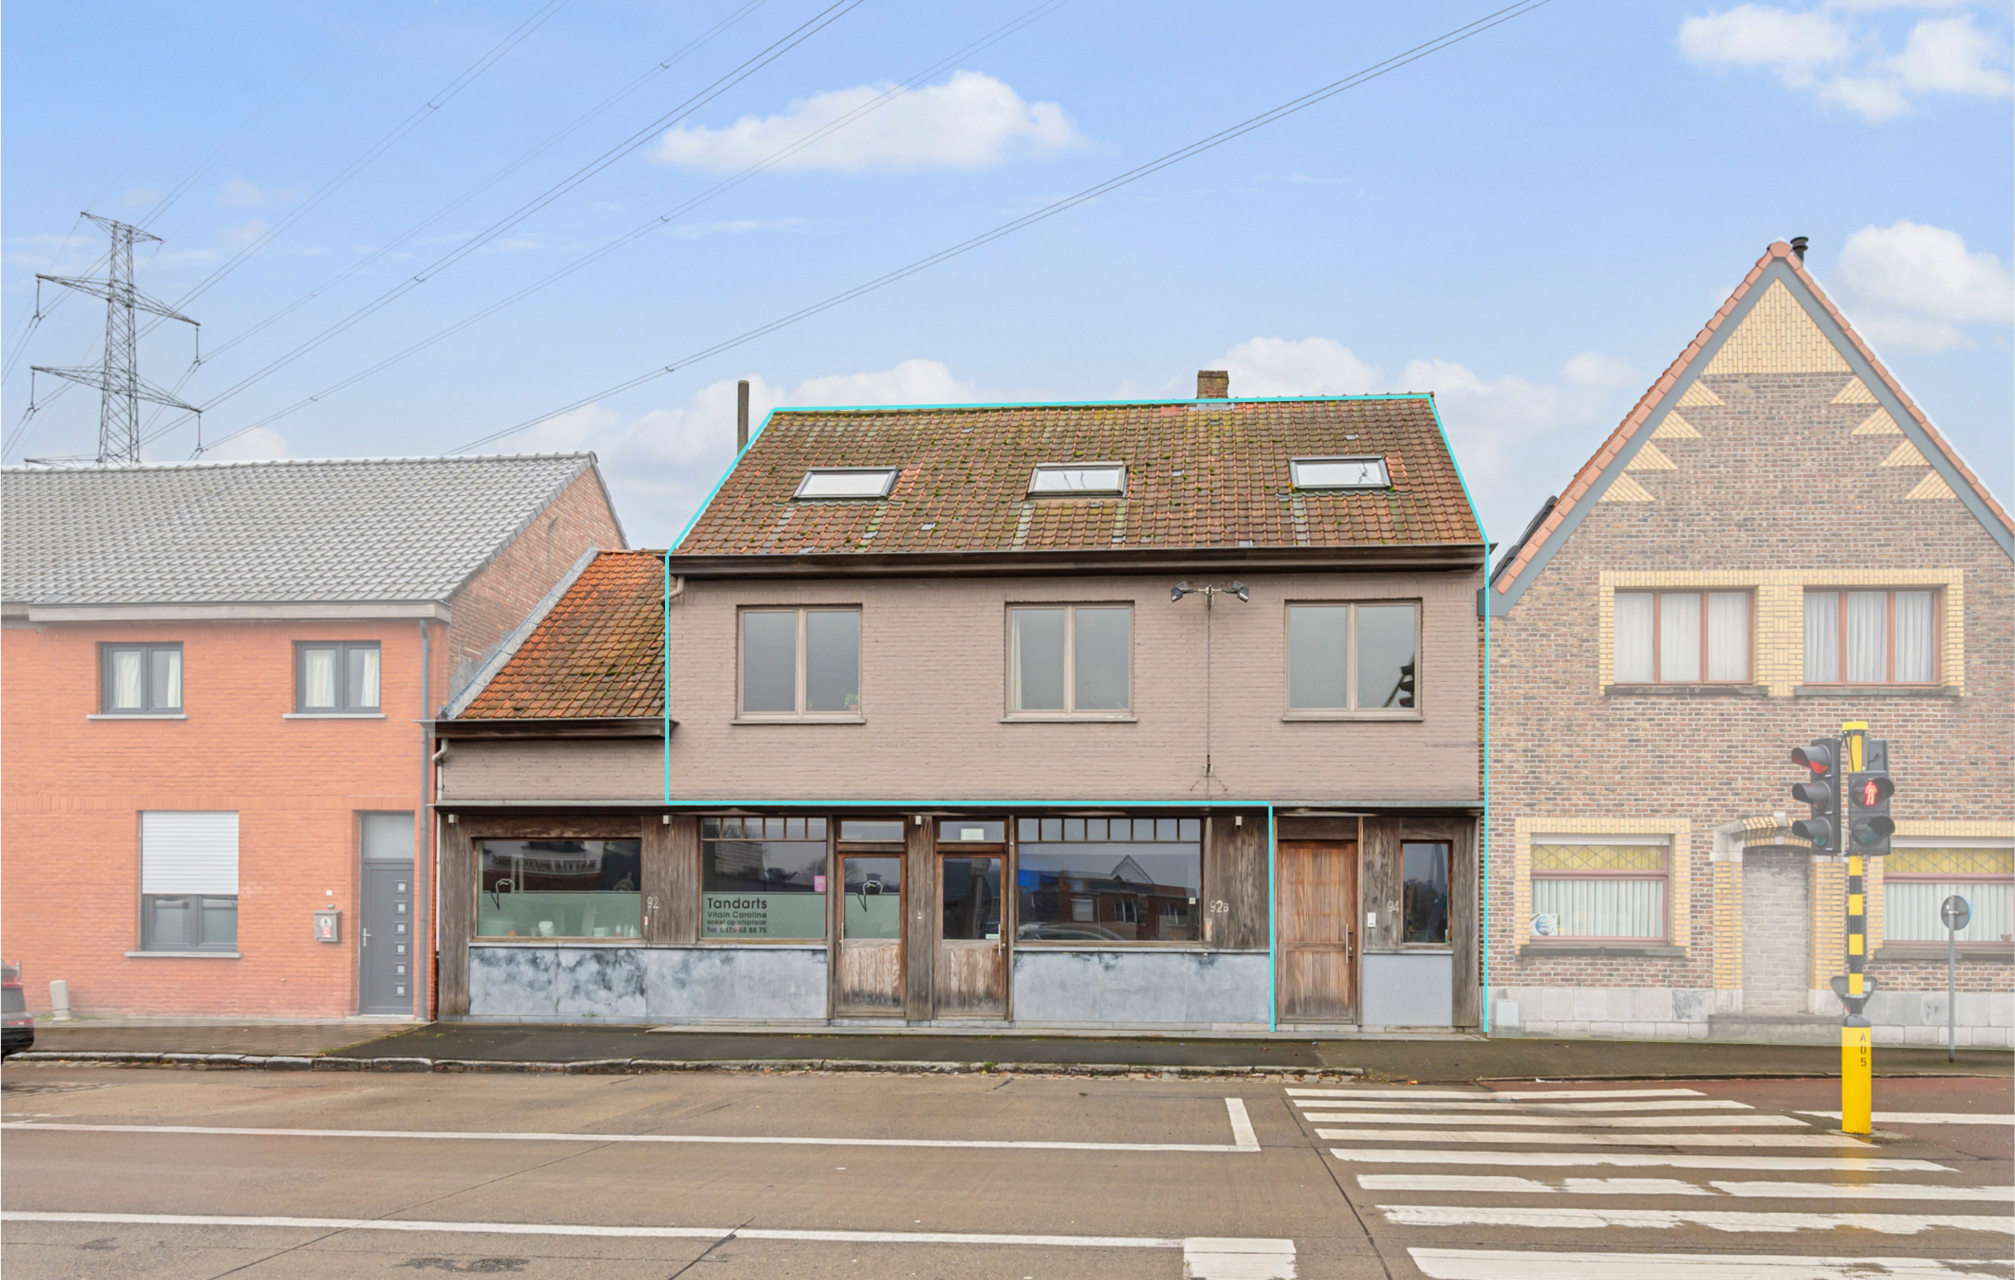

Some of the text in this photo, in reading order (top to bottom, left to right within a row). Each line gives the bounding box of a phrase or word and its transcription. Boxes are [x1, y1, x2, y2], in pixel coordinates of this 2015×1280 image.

[647, 896, 660, 909] 92
[707, 898, 767, 909] Tandarts
[1387, 900, 1400, 914] 94
